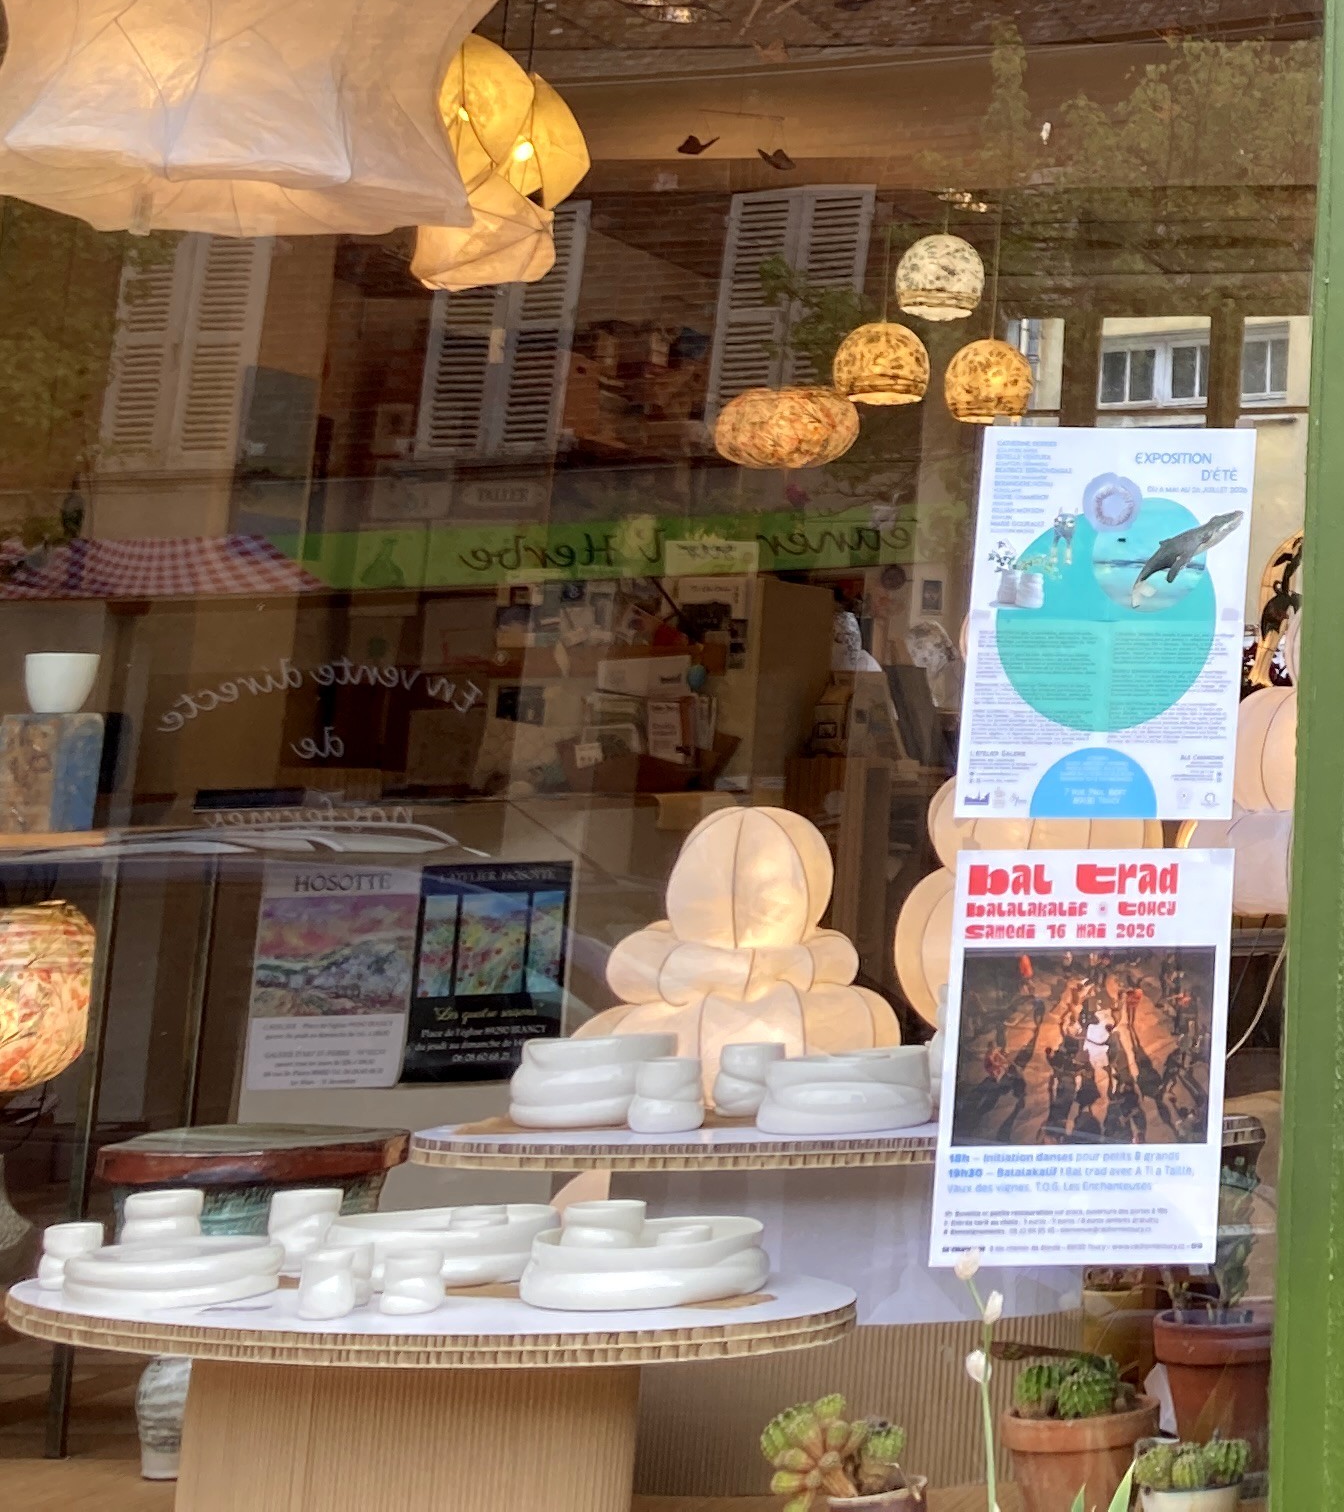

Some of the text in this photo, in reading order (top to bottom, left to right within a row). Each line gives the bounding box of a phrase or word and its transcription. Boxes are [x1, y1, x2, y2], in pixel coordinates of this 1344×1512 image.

[1135, 452, 1212, 465] EXPOSITION
[1046, 923, 1067, 939] 16
[1116, 923, 1156, 939] 2026
[949, 1153, 970, 1164] 18h
[983, 1152, 1034, 1163] Initiation
[1035, 1152, 1073, 1162] danses
[1075, 1152, 1100, 1163] pour
[1143, 1150, 1180, 1162] grands
[948, 1167, 983, 1178] 19h30
[1109, 1166, 1133, 1176] avec
[975, 1183, 993, 1193] des
